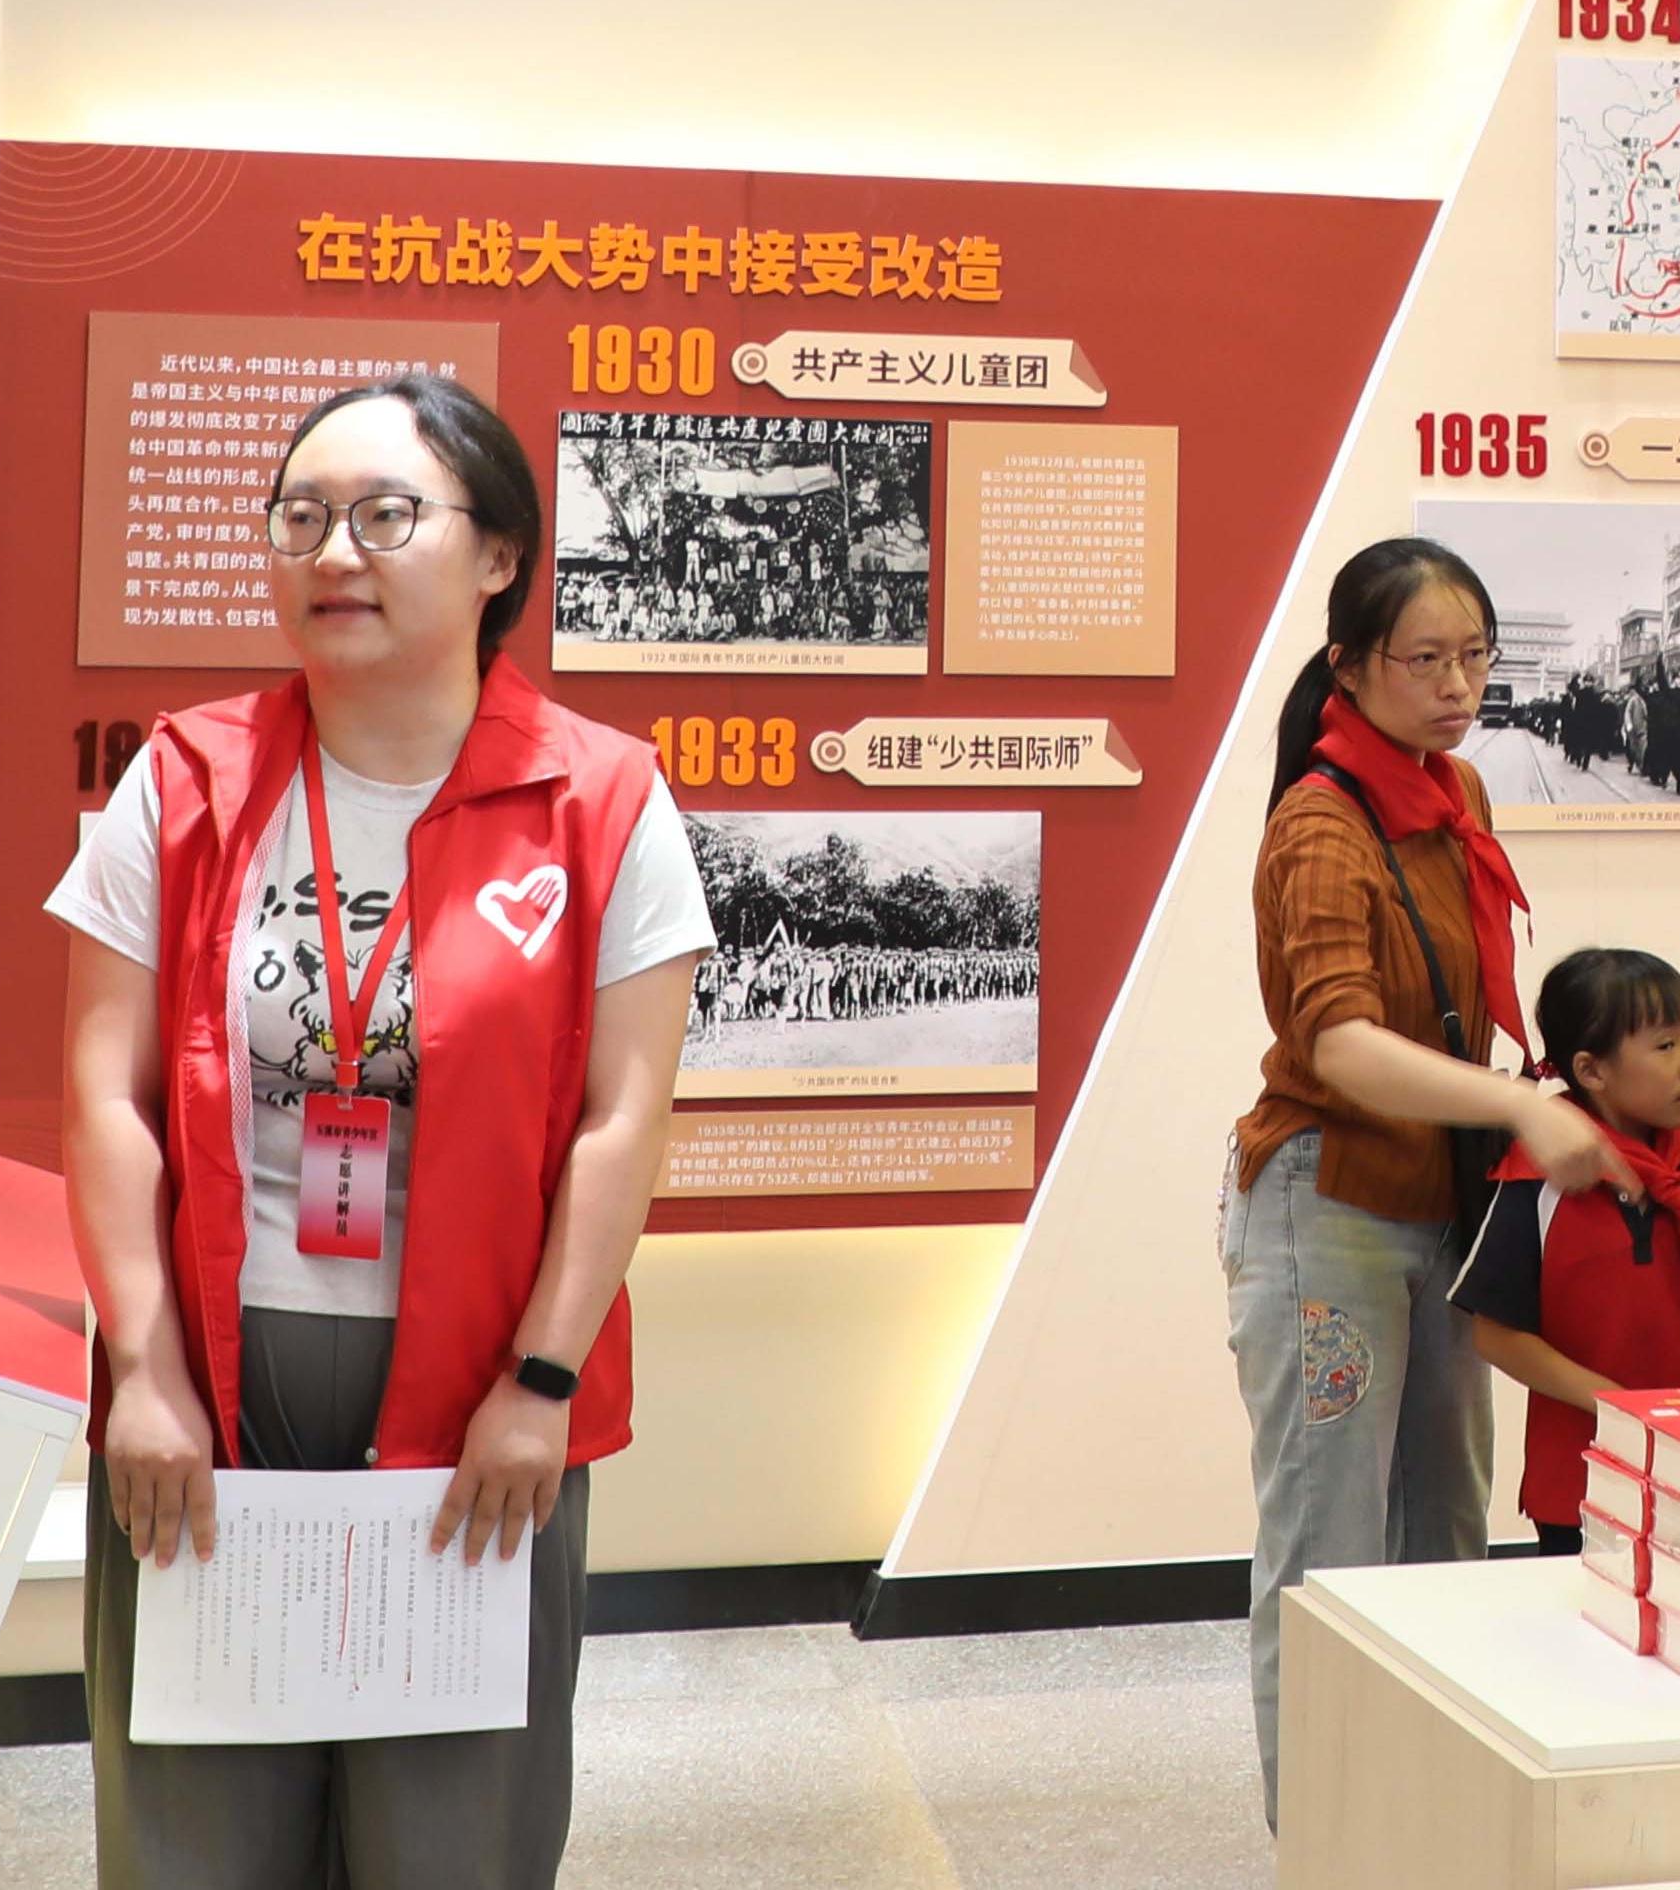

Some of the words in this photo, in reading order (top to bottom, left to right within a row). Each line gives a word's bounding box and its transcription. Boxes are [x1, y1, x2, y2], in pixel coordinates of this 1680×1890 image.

[297, 212, 1004, 304] 在抗战大势中接受改造
[566, 323, 716, 397] 1930
[791, 348, 1049, 391] 共产主义儿童团
[132, 382, 339, 403] 是帝国主义与中华民族的
[1416, 412, 1548, 478] 1935
[127, 522, 266, 542] 产党,审时度势,
[126, 551, 269, 570] 调整。共青团的改
[125, 579, 270, 599] 景下完成的。从此
[124, 607, 278, 627] 现为发散性、包容性
[650, 716, 797, 787] 1933
[867, 734, 1095, 772] 组建“少共国际师”
[336, 1144, 353, 1237] 志愿讲解员
